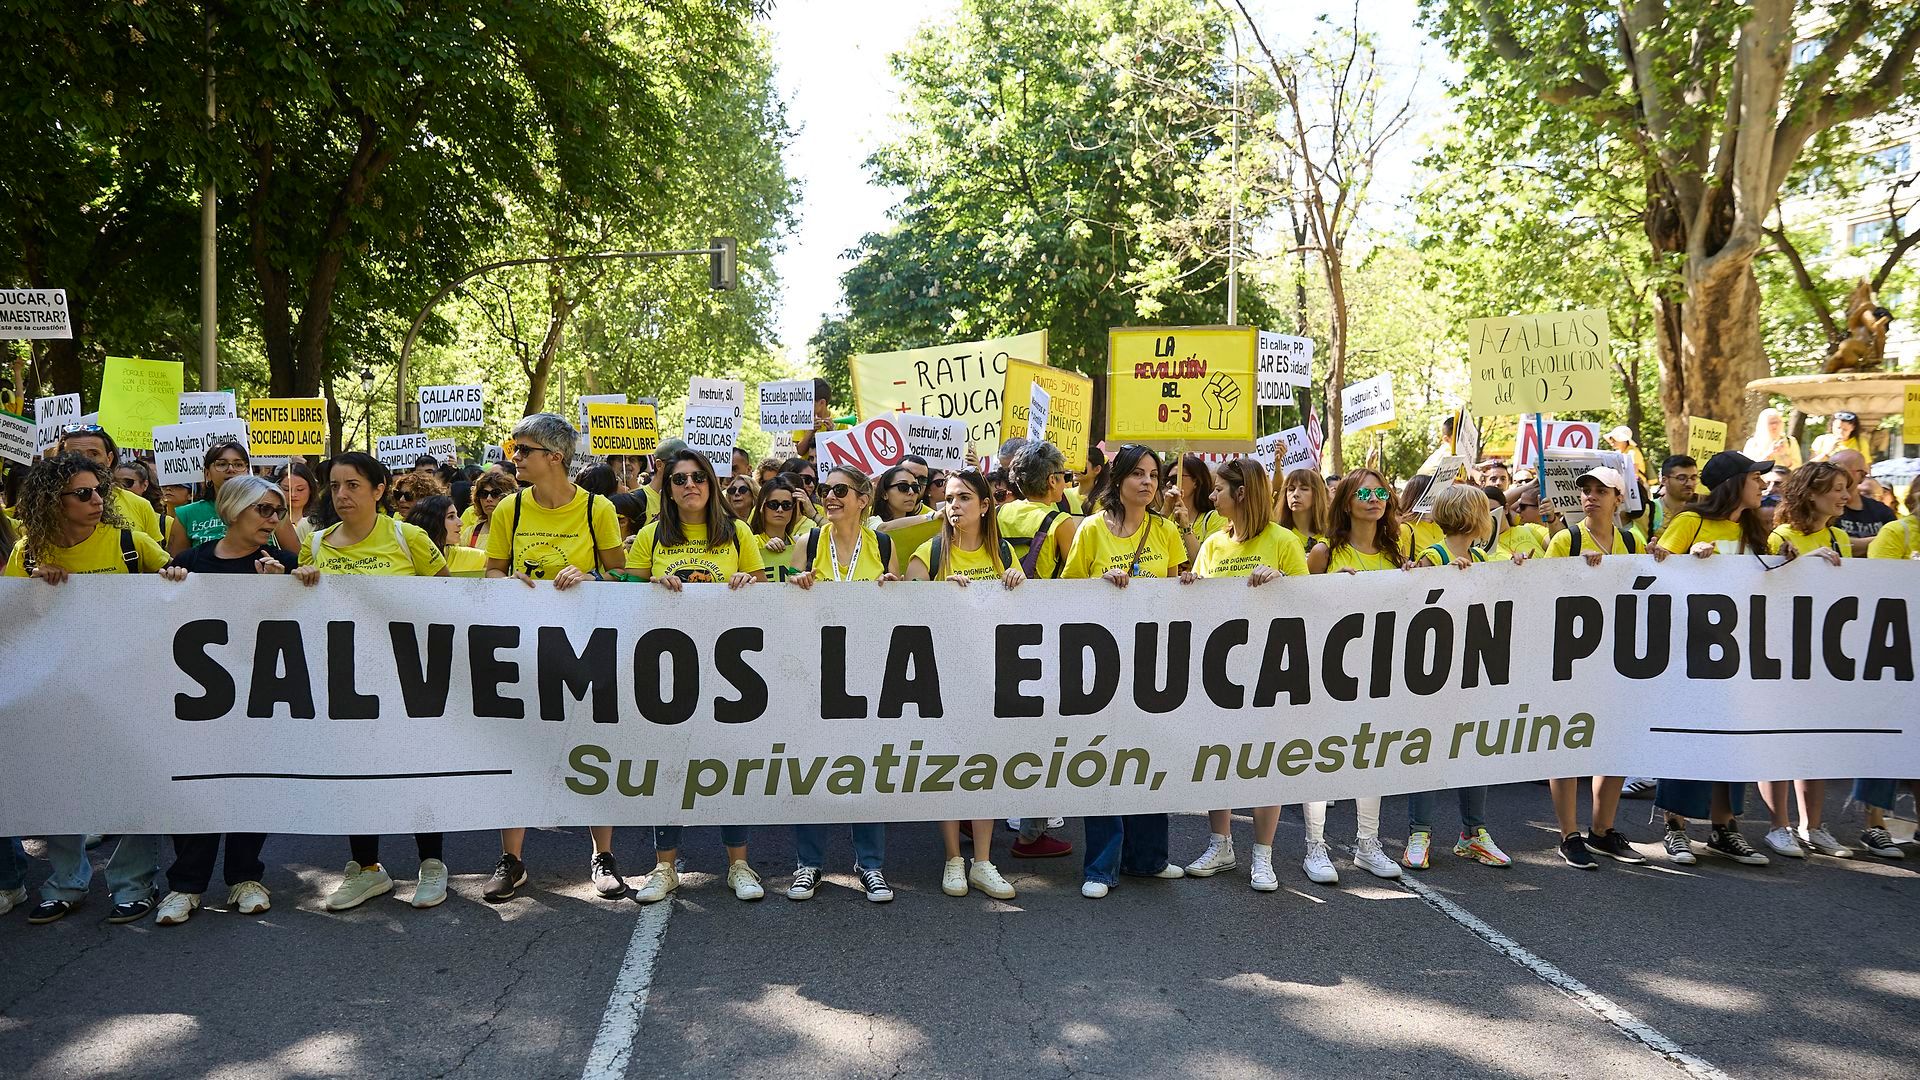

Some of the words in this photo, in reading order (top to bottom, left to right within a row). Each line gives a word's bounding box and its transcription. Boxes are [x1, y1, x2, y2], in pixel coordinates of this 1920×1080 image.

[54, 293, 64, 305] O
[1479, 315, 1599, 355] AZALEAS
[1155, 336, 1175, 357] LA
[1134, 353, 1207, 379] REVOLUCIÓN
[1276, 355, 1289, 373] ES
[1481, 367, 1495, 381] en
[1501, 358, 1514, 379] la
[422, 390, 464, 404] CALLAR
[467, 389, 481, 402] ES
[1161, 381, 1181, 399] DEL
[1536, 375, 1572, 403] 0-3
[57, 398, 74, 416] NOS
[423, 408, 482, 423] COMPLICIDAD
[1157, 403, 1192, 423] 0-3
[251, 408, 289, 422] MENTES
[291, 408, 324, 425] LIBRES,
[591, 415, 625, 429] MENTES
[626, 416, 656, 432] LIBRES,
[696, 416, 733, 429] ESCUELAS
[251, 431, 295, 446] SOCIEDAD
[297, 431, 324, 446] LAICA.
[687, 430, 732, 447] PÚBLICAS
[908, 423, 941, 440] Instruir,
[942, 424, 952, 441] SÍ.
[1287, 433, 1301, 446] PP,
[154, 438, 174, 454] Como
[175, 436, 200, 454] Aguirre
[200, 437, 205, 452] y
[379, 438, 414, 452] CALLAR
[416, 436, 427, 449] ES
[592, 436, 632, 449] SOCIEDAD
[633, 437, 657, 450] LIBRE
[826, 419, 905, 477] NO
[1066, 436, 1078, 452] LA
[946, 447, 962, 461] NO.
[164, 457, 191, 475] AYUSO,
[172, 618, 769, 726] SALVEMOS
[820, 625, 944, 720] LA
[993, 588, 1514, 719] EDUCACIÓN
[1552, 575, 1915, 682] PÚBLICA
[565, 743, 658, 797] Su
[681, 735, 1165, 810] privatización,
[1194, 723, 1432, 782] nuestra
[1449, 704, 1594, 758] ruina
